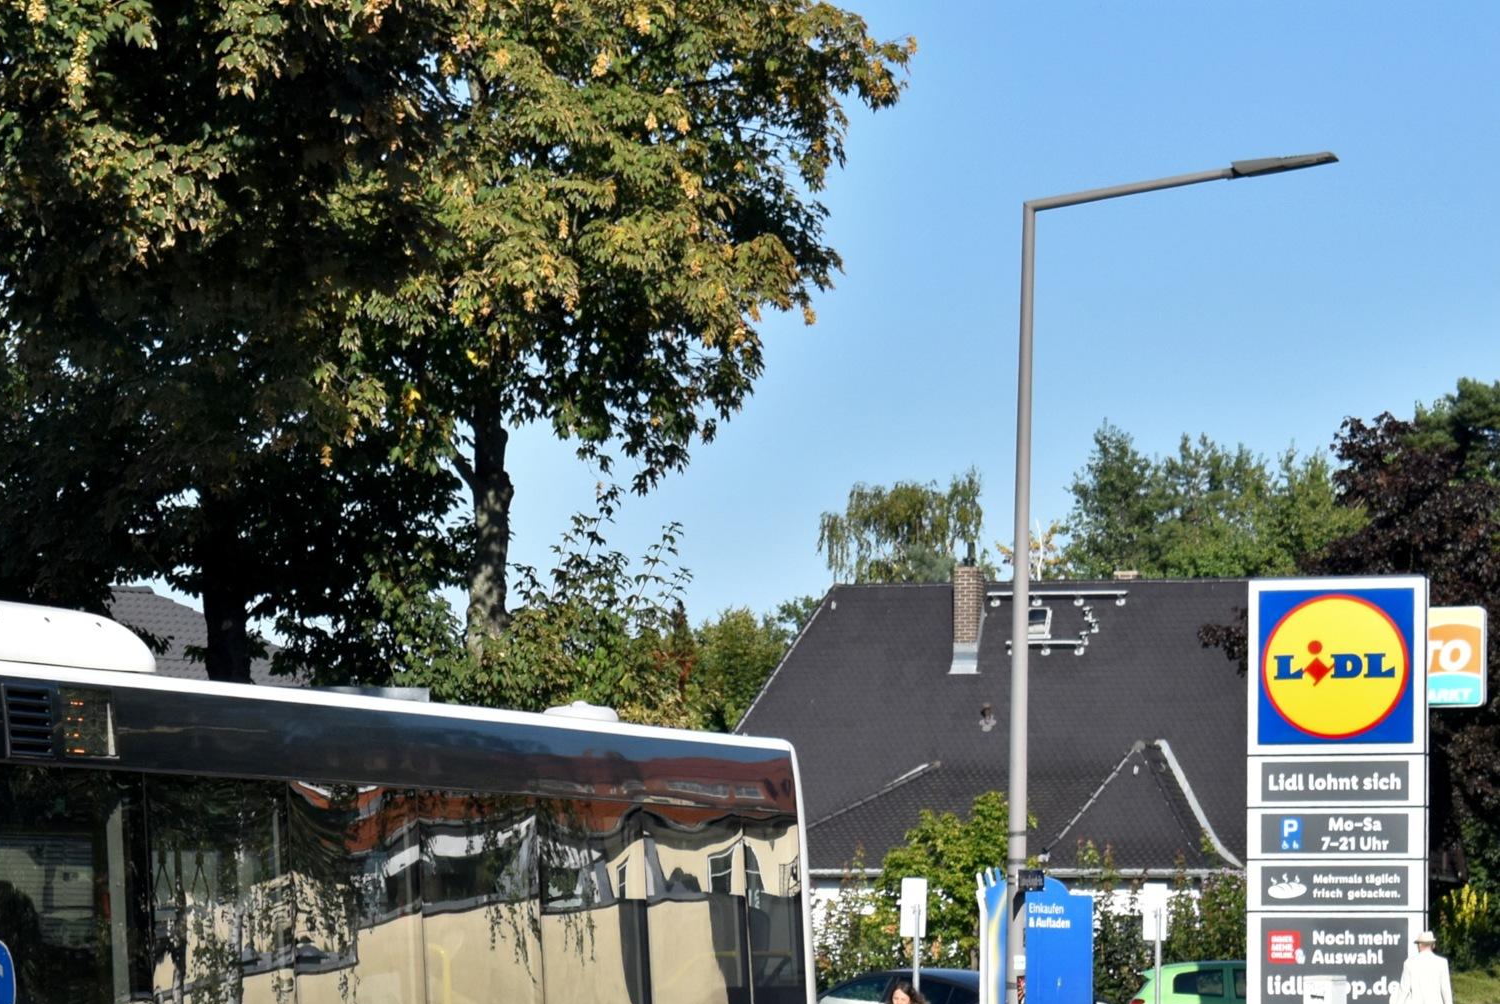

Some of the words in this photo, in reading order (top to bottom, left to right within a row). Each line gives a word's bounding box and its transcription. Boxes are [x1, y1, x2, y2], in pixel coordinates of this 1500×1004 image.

[1268, 773, 1304, 791] Lidl
[1308, 773, 1359, 791] lohnt
[1363, 772, 1402, 790] sich
[1283, 819, 1298, 837] P
[1359, 836, 1389, 851] Uhr
[1313, 874, 1362, 884] Mehrmals
[1365, 873, 1401, 886] täglich
[1312, 888, 1343, 898] frisch
[1347, 888, 1401, 900] gebacken.
[1028, 902, 1064, 914] Einkaufen
[1028, 917, 1035, 928] &
[1036, 917, 1071, 928] Aufladen
[1312, 930, 1355, 945] Noch
[1358, 930, 1401, 945] mehr
[1311, 949, 1384, 964] Auswahl
